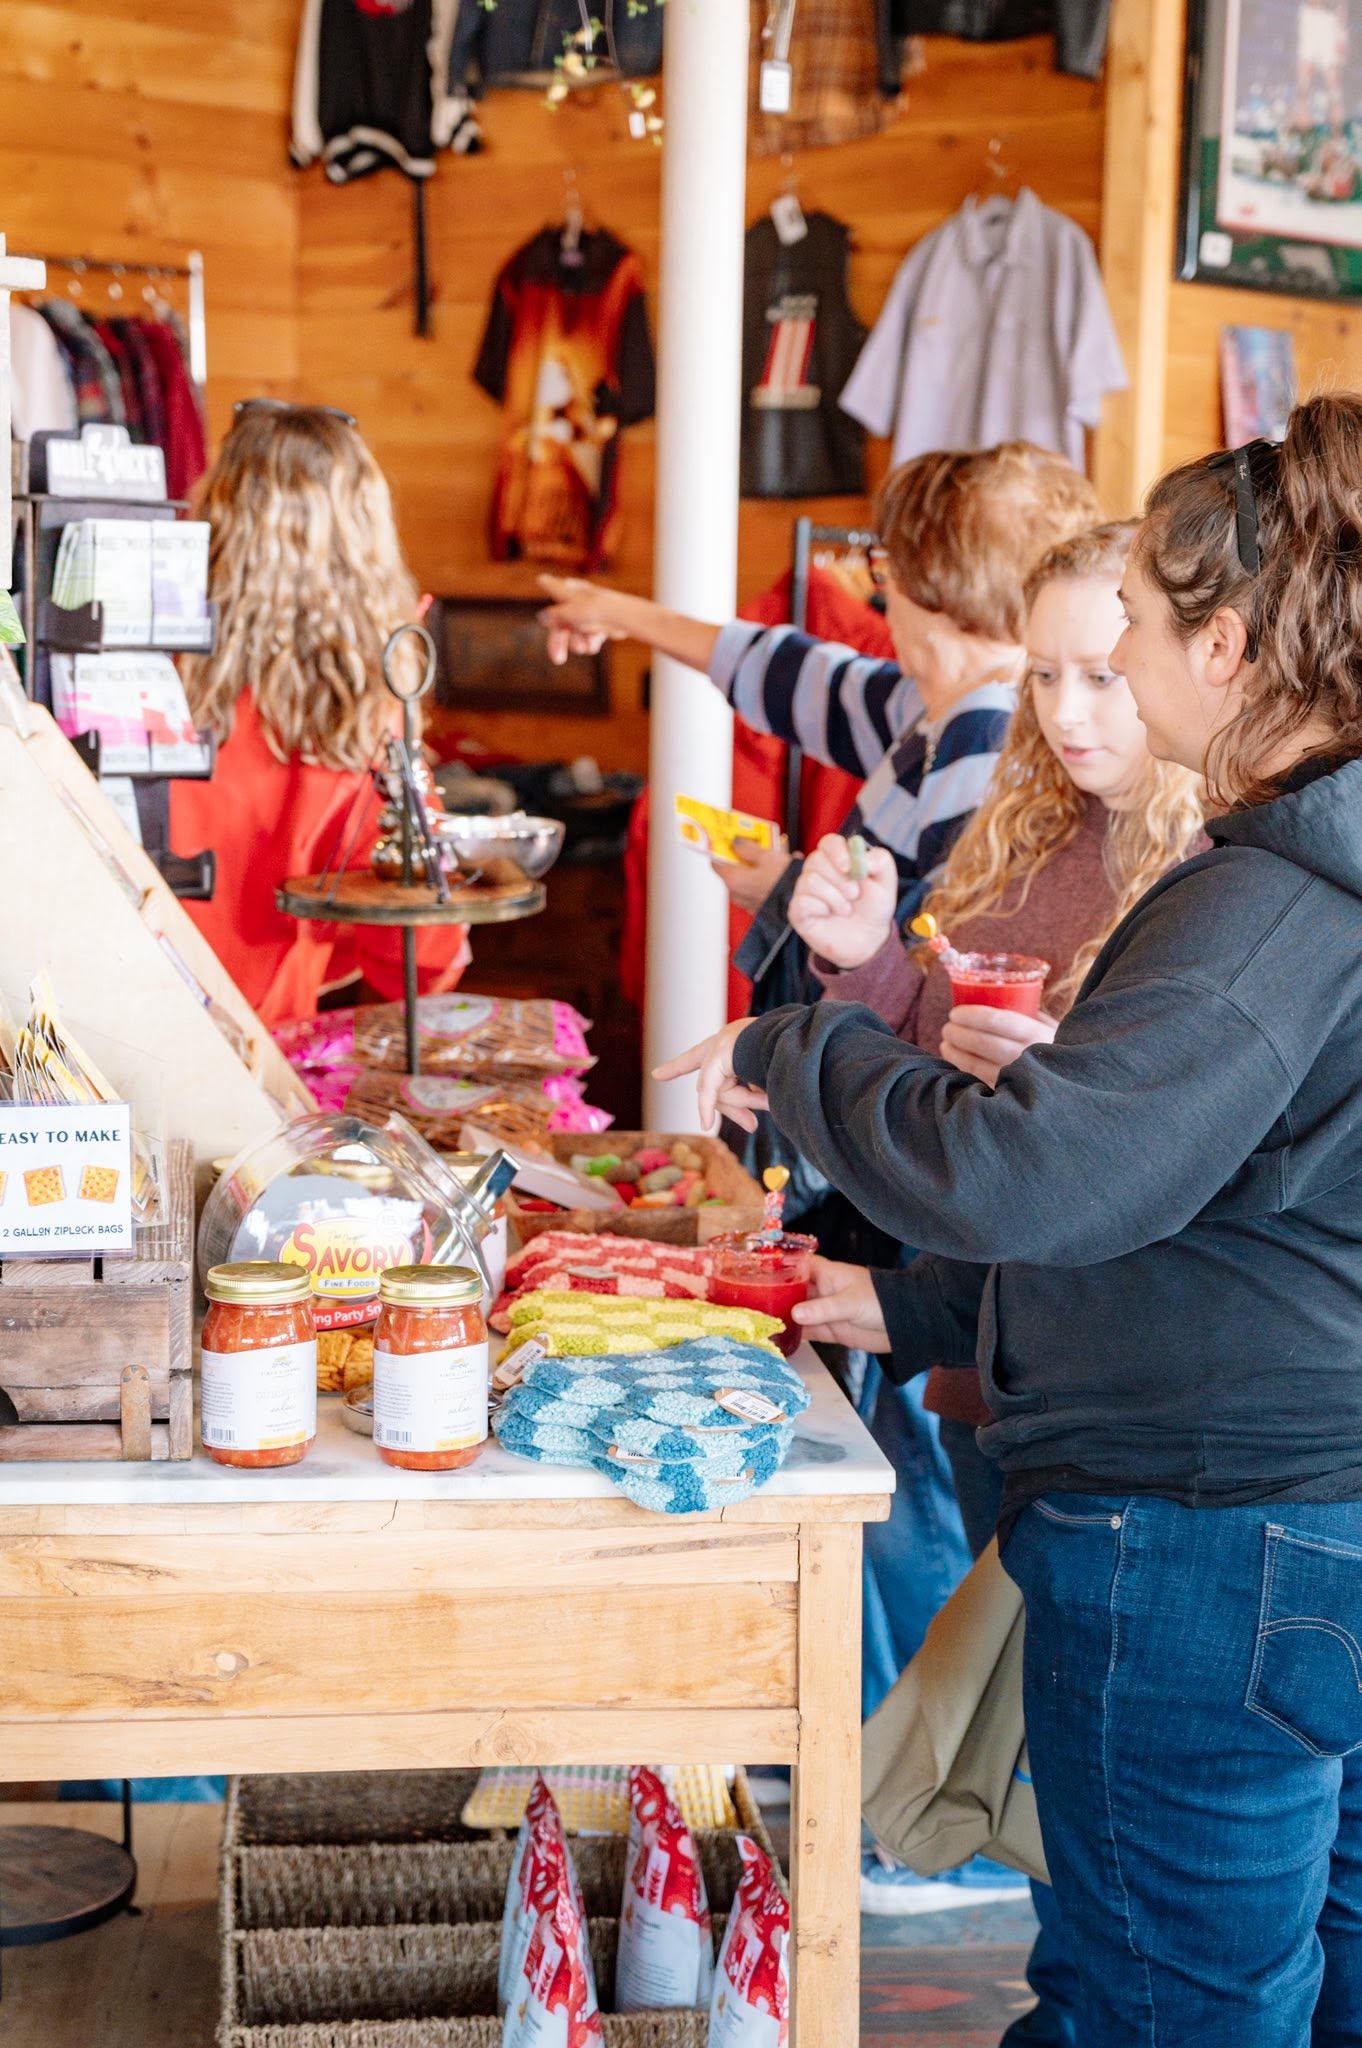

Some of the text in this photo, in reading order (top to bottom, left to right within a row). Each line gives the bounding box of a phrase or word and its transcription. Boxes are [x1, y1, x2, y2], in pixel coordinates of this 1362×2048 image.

[0, 1129, 121, 1144] EASY TO MAKE
[3, 1224, 124, 1237] 2 GALLON ZIPLOCK BAGS
[334, 1309, 364, 1323] Party
